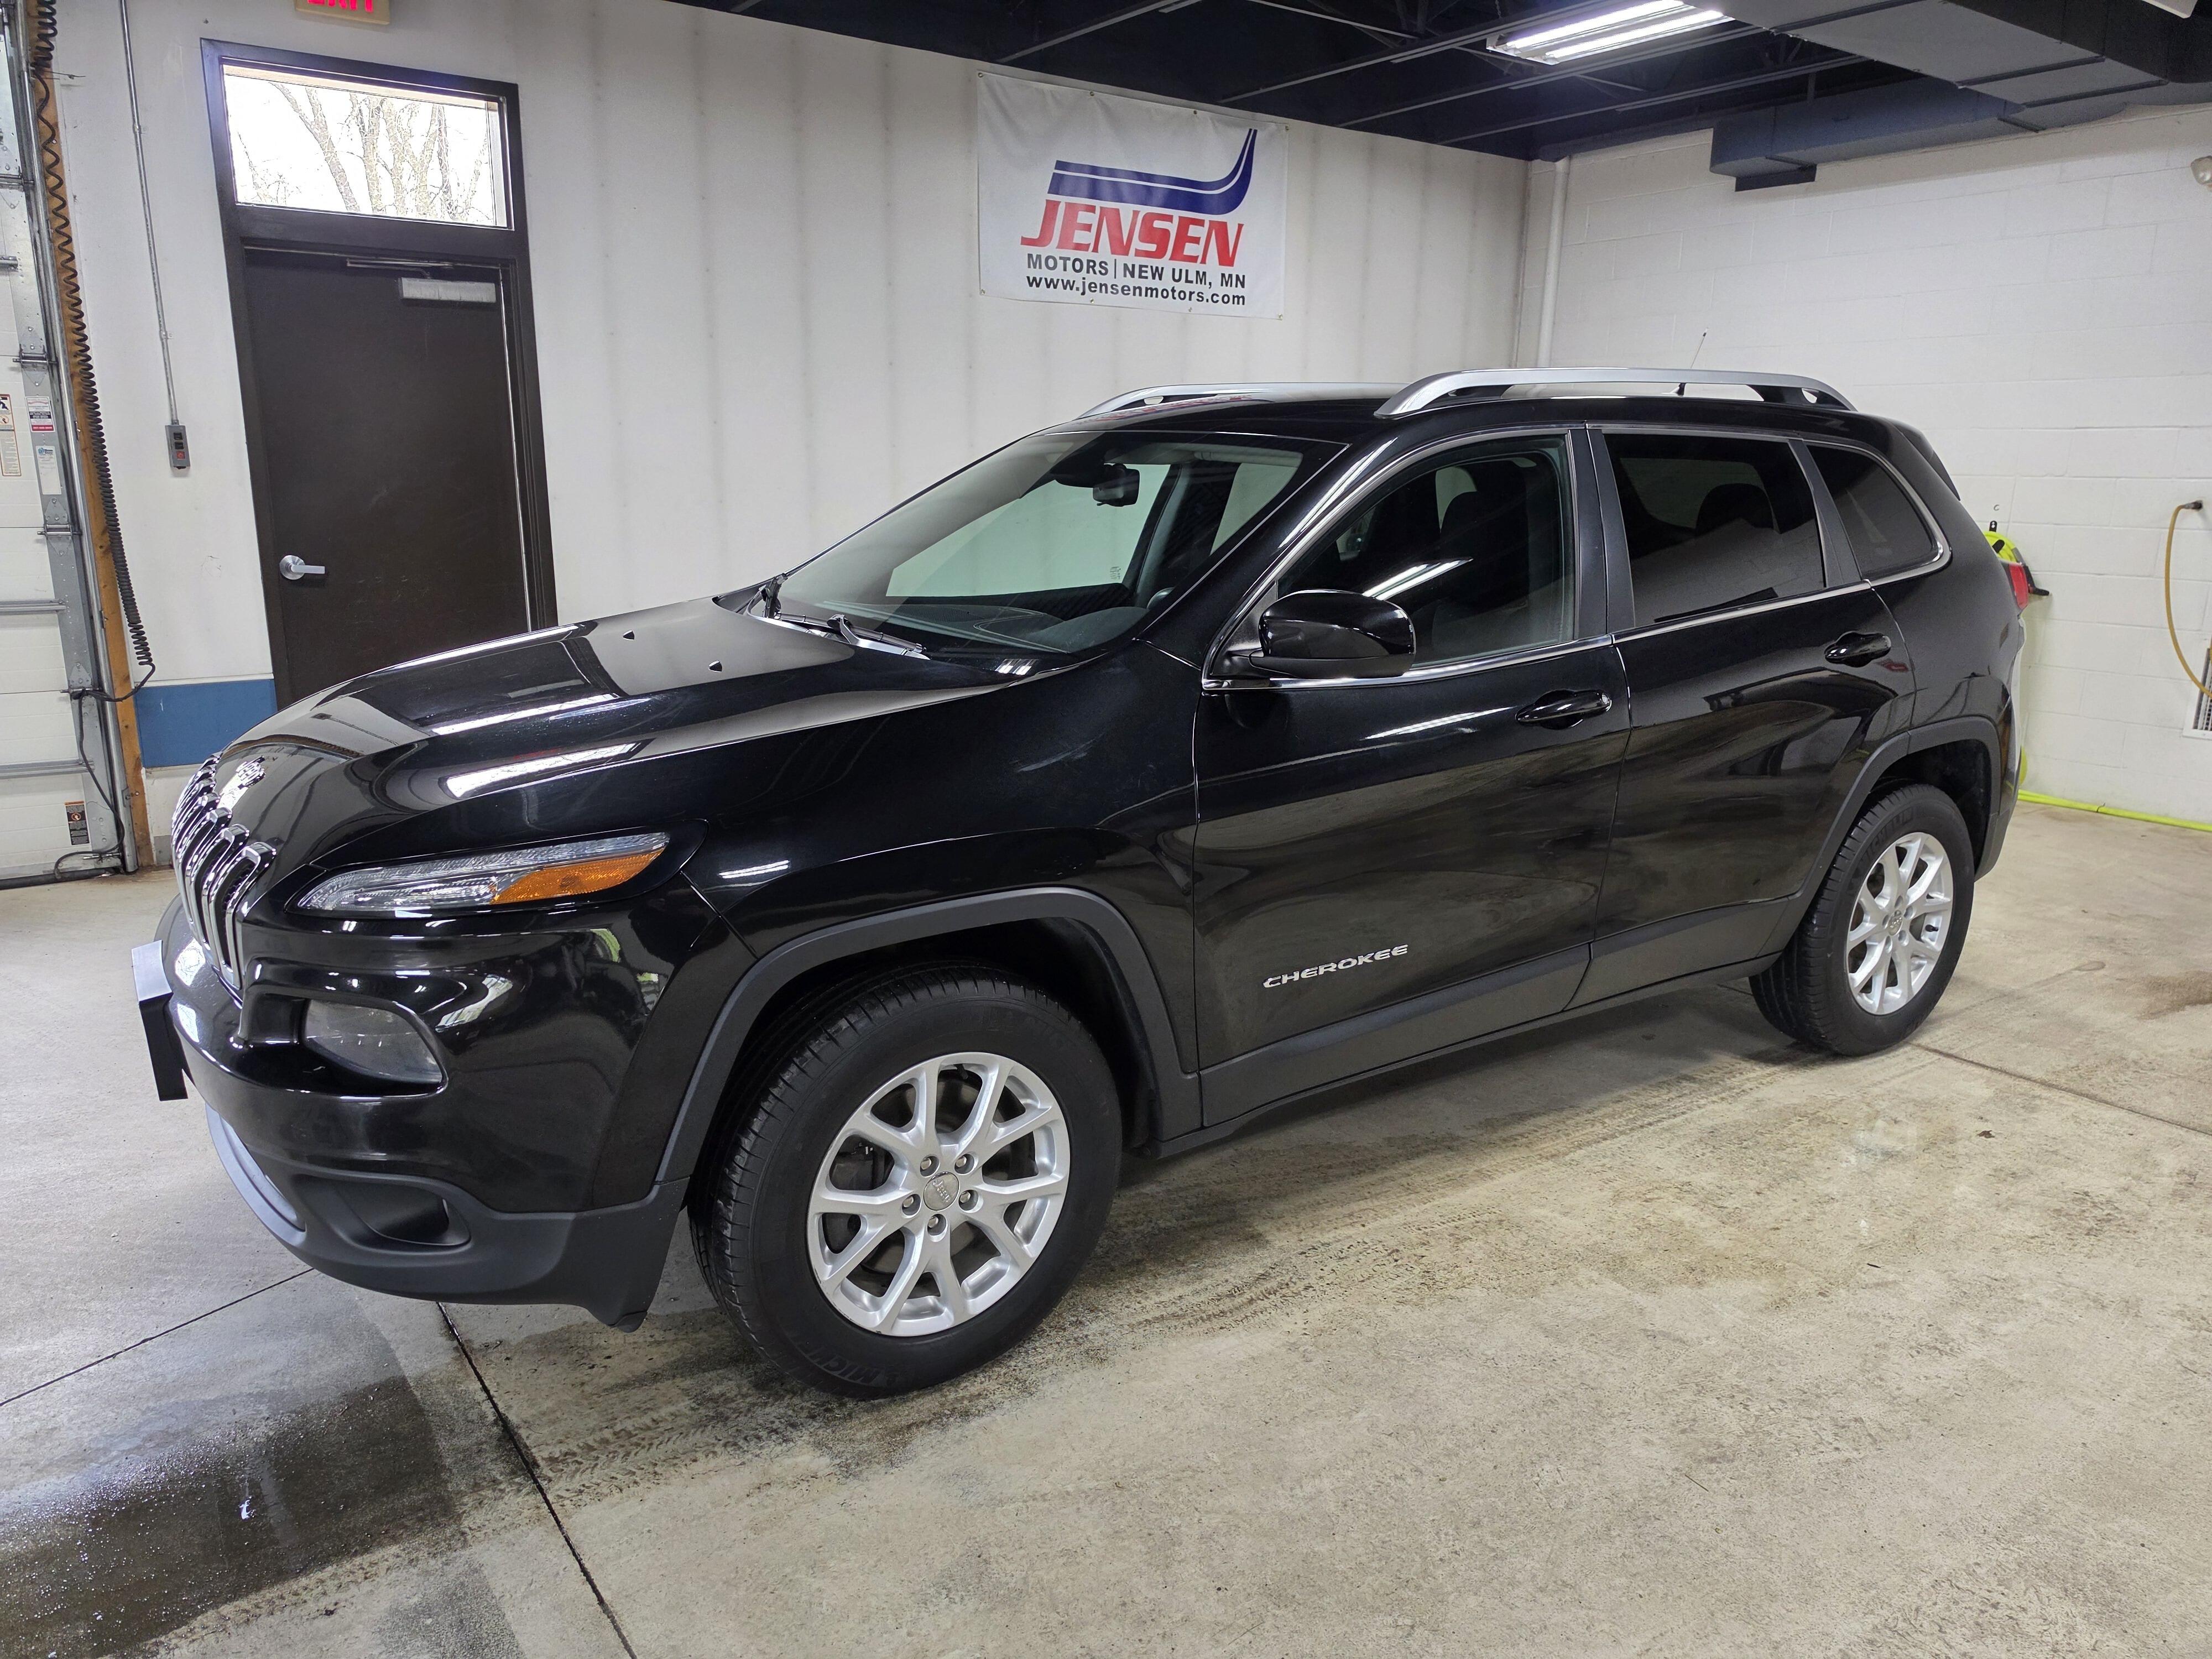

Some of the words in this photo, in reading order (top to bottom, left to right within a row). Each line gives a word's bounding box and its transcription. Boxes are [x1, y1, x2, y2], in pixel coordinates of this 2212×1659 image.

[1020, 199, 1244, 267] JENSEN
[1026, 276, 1245, 305] www.jensenmotors.com
[1027, 253, 1109, 276] MOTORS
[1123, 263, 1164, 281] NEW
[1172, 268, 1212, 289] ULM,
[1220, 273, 1245, 289] MN
[1263, 944, 1408, 988] CHEROKEE
